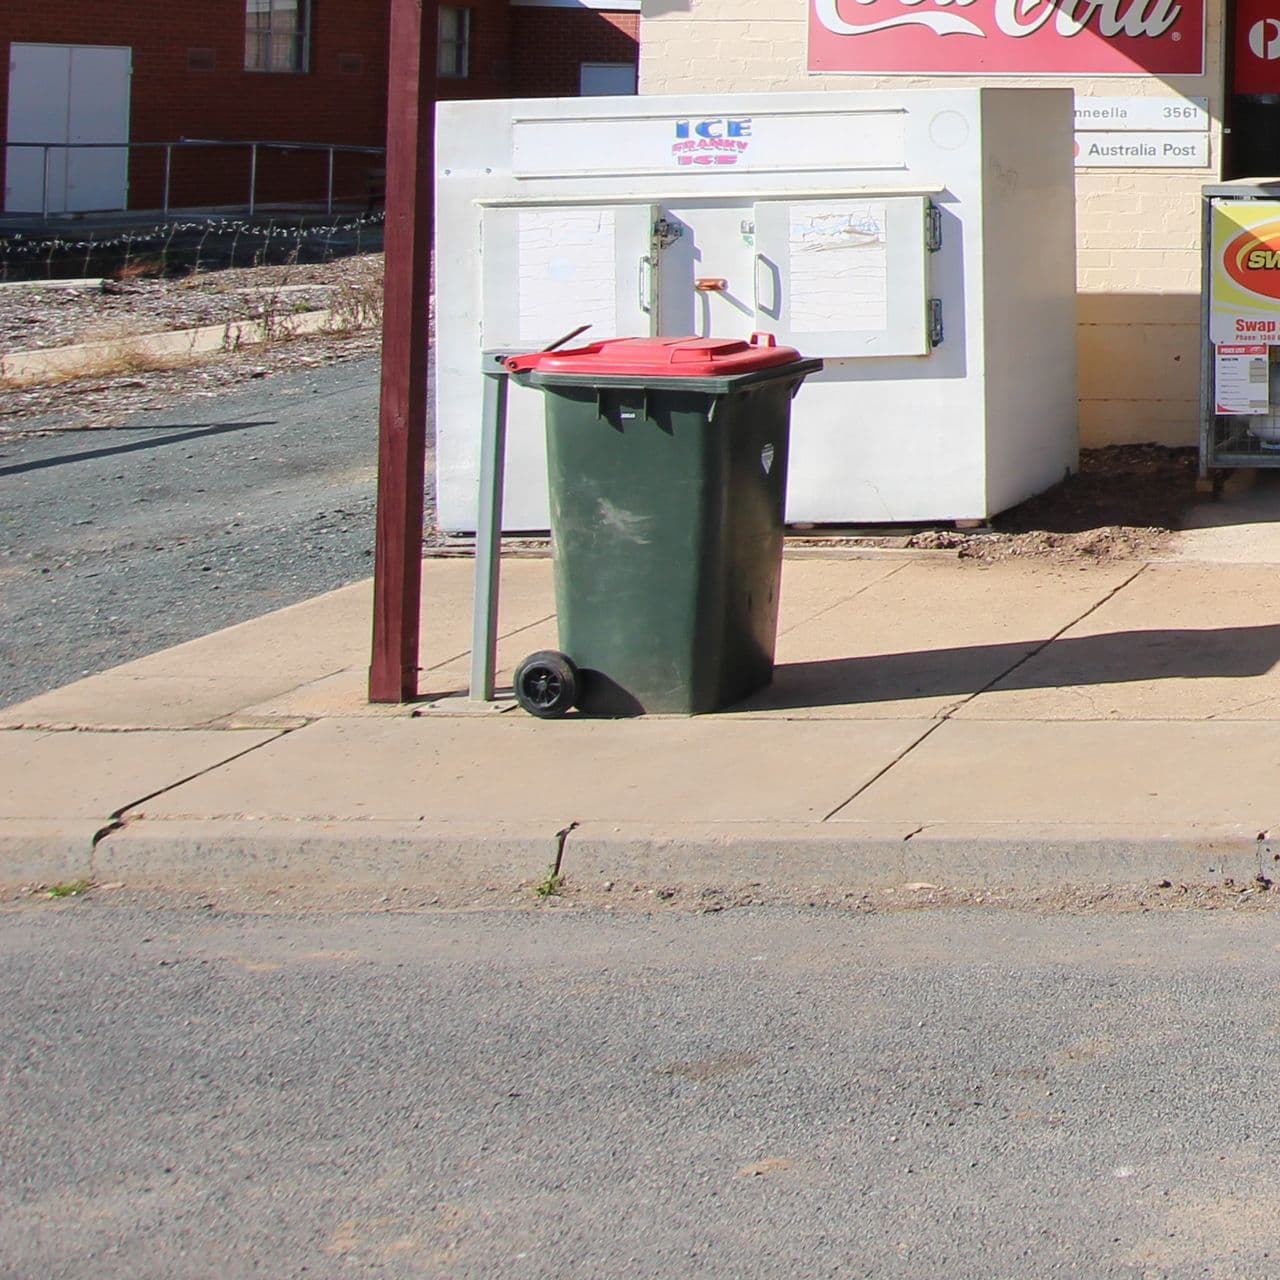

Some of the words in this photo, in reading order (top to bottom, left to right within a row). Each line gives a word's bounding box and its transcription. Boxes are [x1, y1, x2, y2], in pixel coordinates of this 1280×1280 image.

[1074, 107, 1128, 118] nneella
[1162, 107, 1198, 118] 3561
[676, 118, 752, 138] ICE
[1088, 143, 1157, 156] Australia
[1162, 143, 1196, 156] Post
[1235, 319, 1275, 332] Swap
